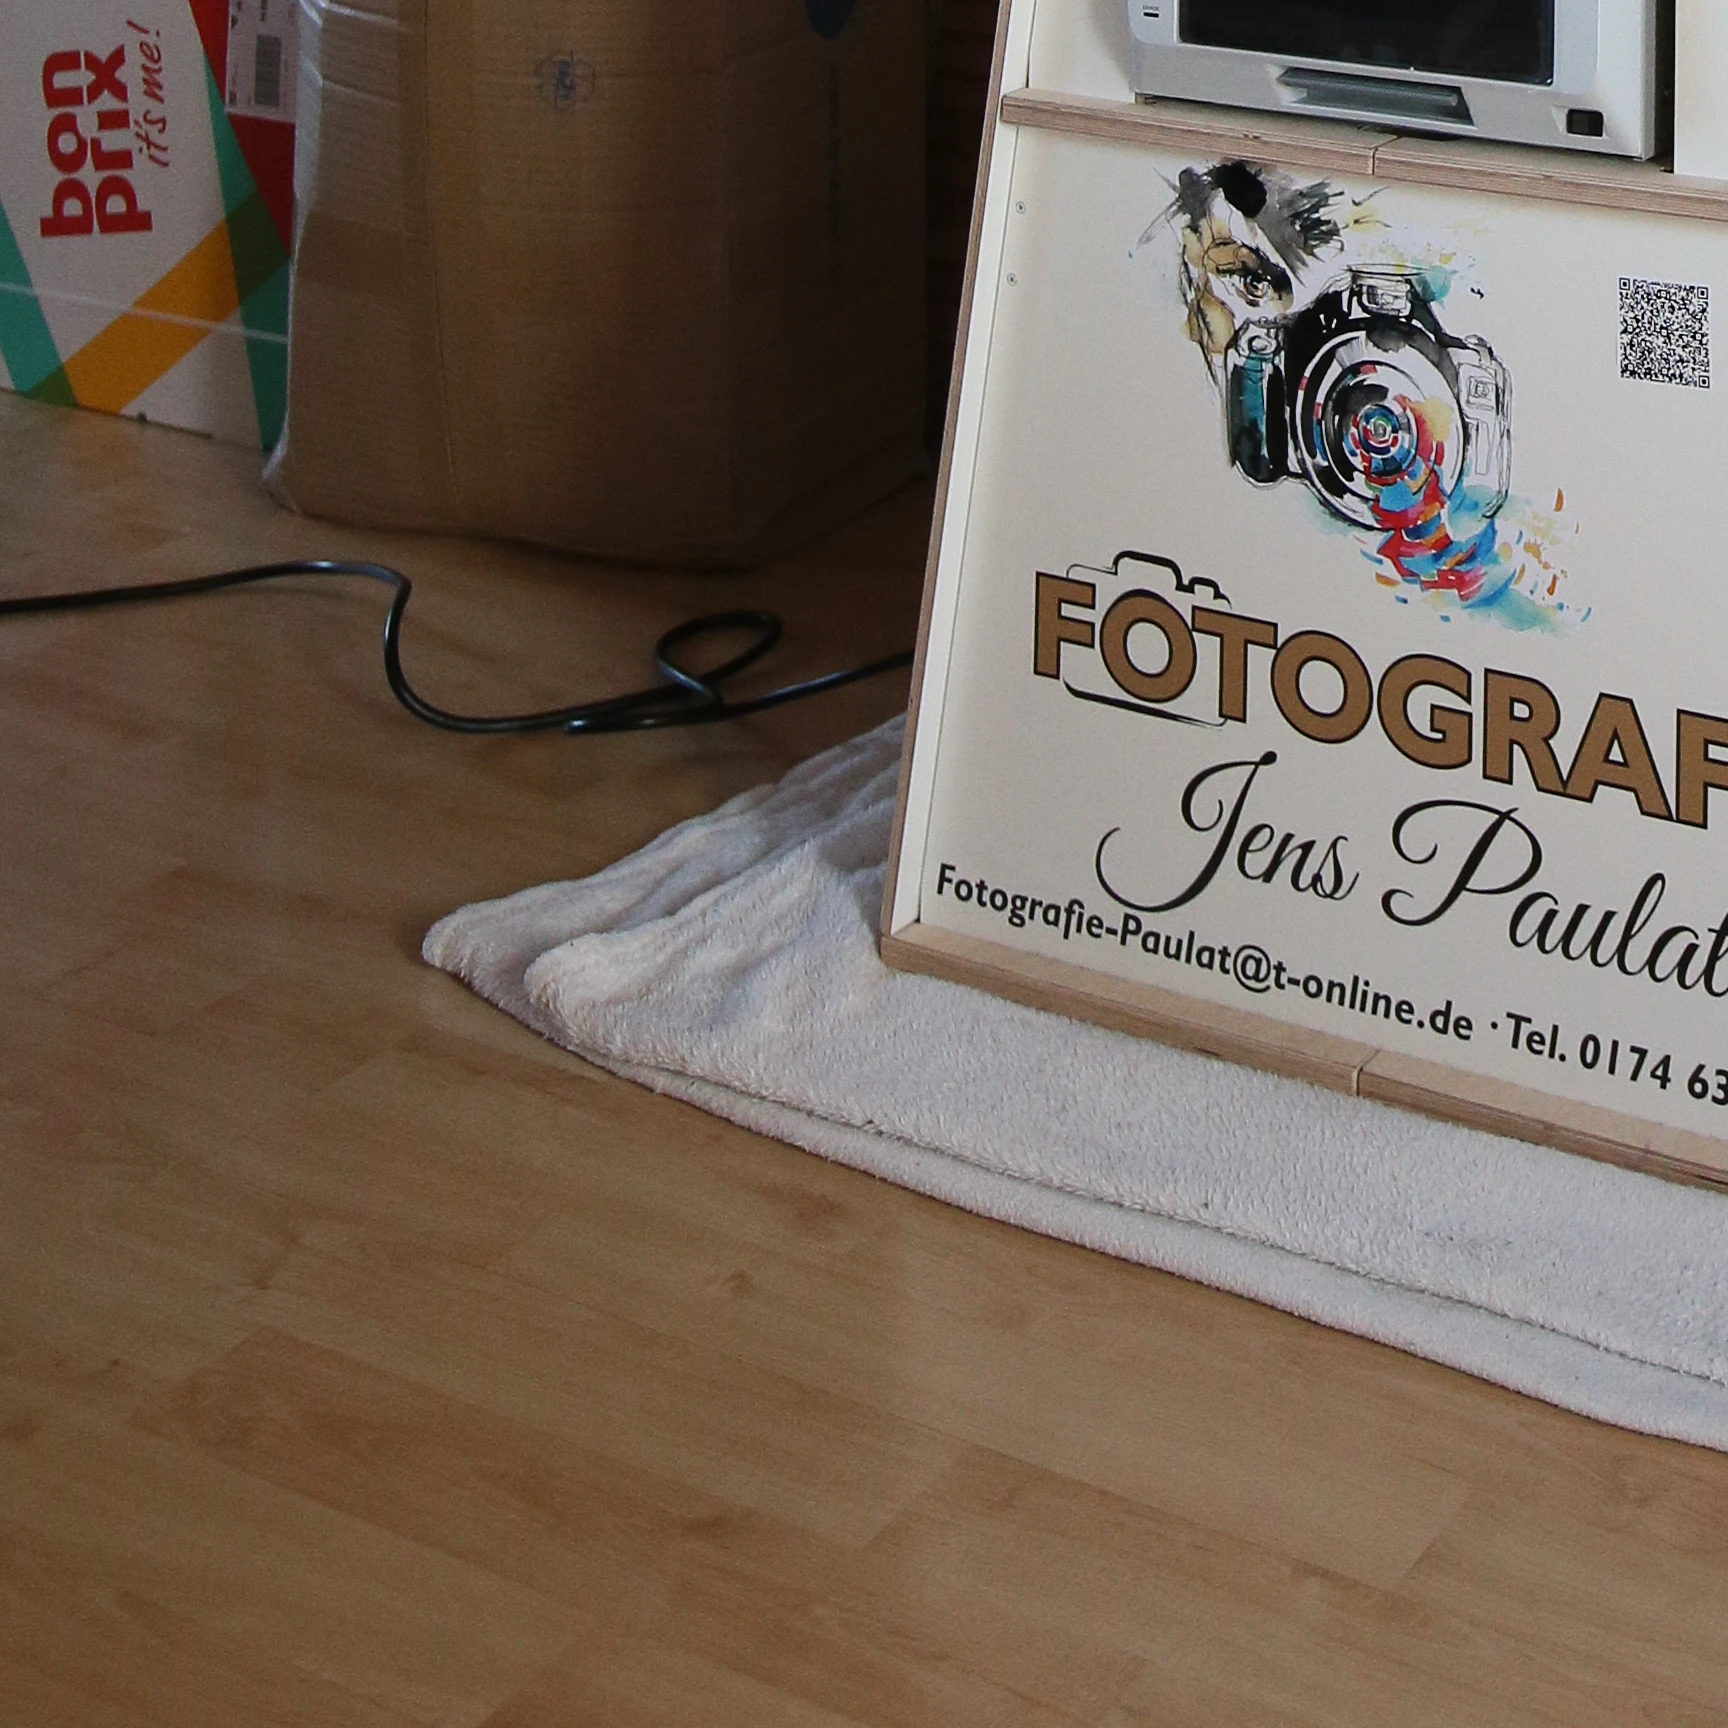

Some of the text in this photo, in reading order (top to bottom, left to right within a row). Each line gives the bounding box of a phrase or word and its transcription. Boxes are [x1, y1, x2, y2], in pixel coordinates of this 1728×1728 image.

[40, 49, 94, 238] bon
[84, 44, 153, 234] prix
[126, 19, 170, 168] it's me!
[1095, 749, 1361, 913] Jens
[936, 862, 1474, 1042] Fotografie-Paulat@t-online.de
[1505, 1011, 1568, 1063] Tel.
[1579, 1033, 1673, 1091] 0174
